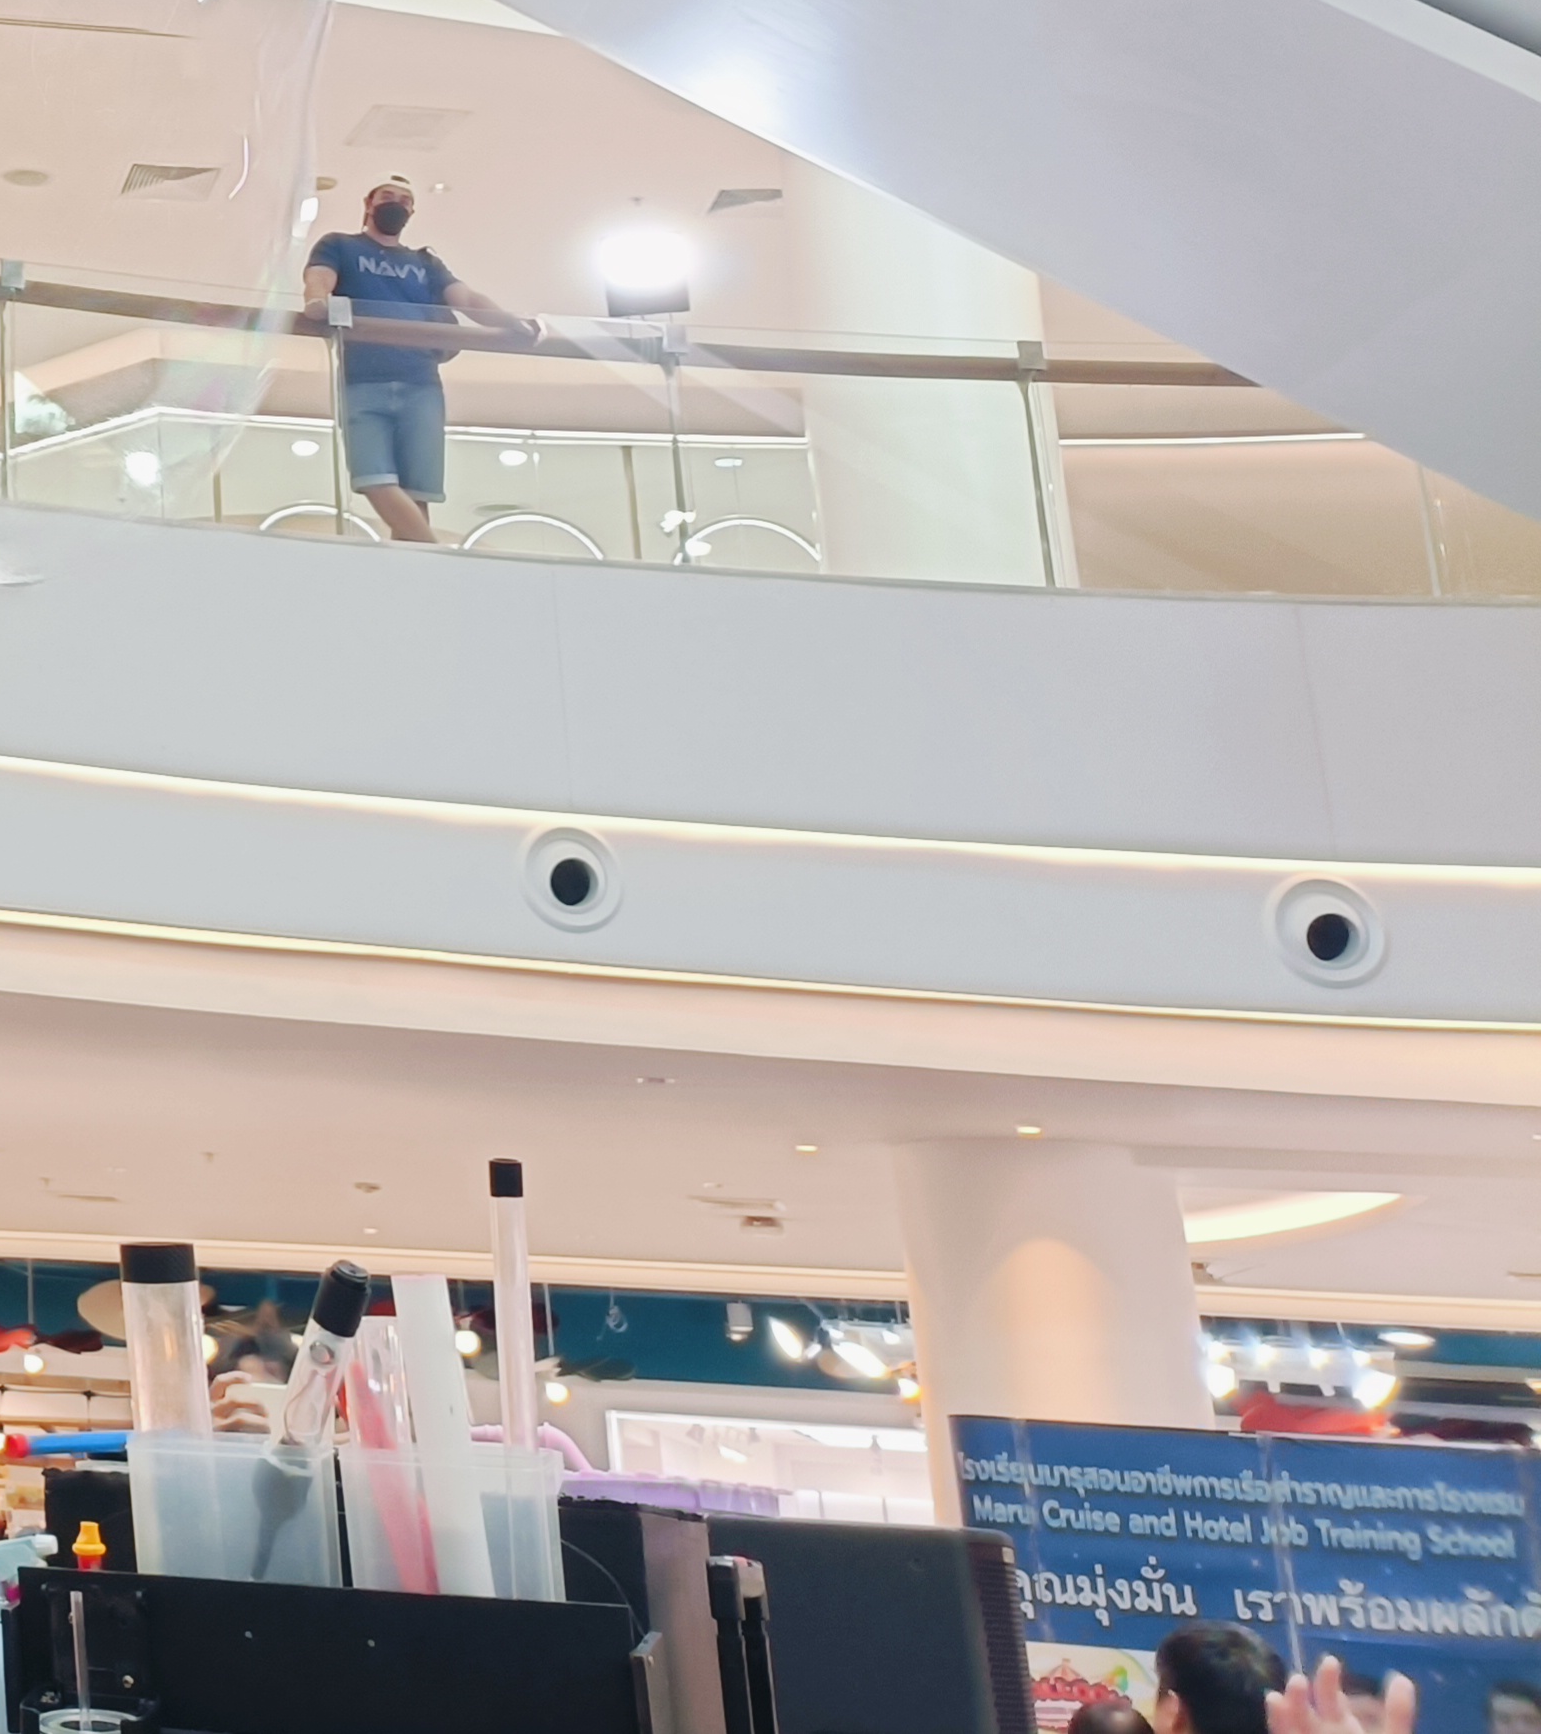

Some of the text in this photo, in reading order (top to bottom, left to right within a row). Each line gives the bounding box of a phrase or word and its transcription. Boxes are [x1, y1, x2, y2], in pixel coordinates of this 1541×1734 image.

[358, 255, 427, 284] NAVY
[972, 1494, 1517, 1561] Maru Cruise and Hotel Job Training School
